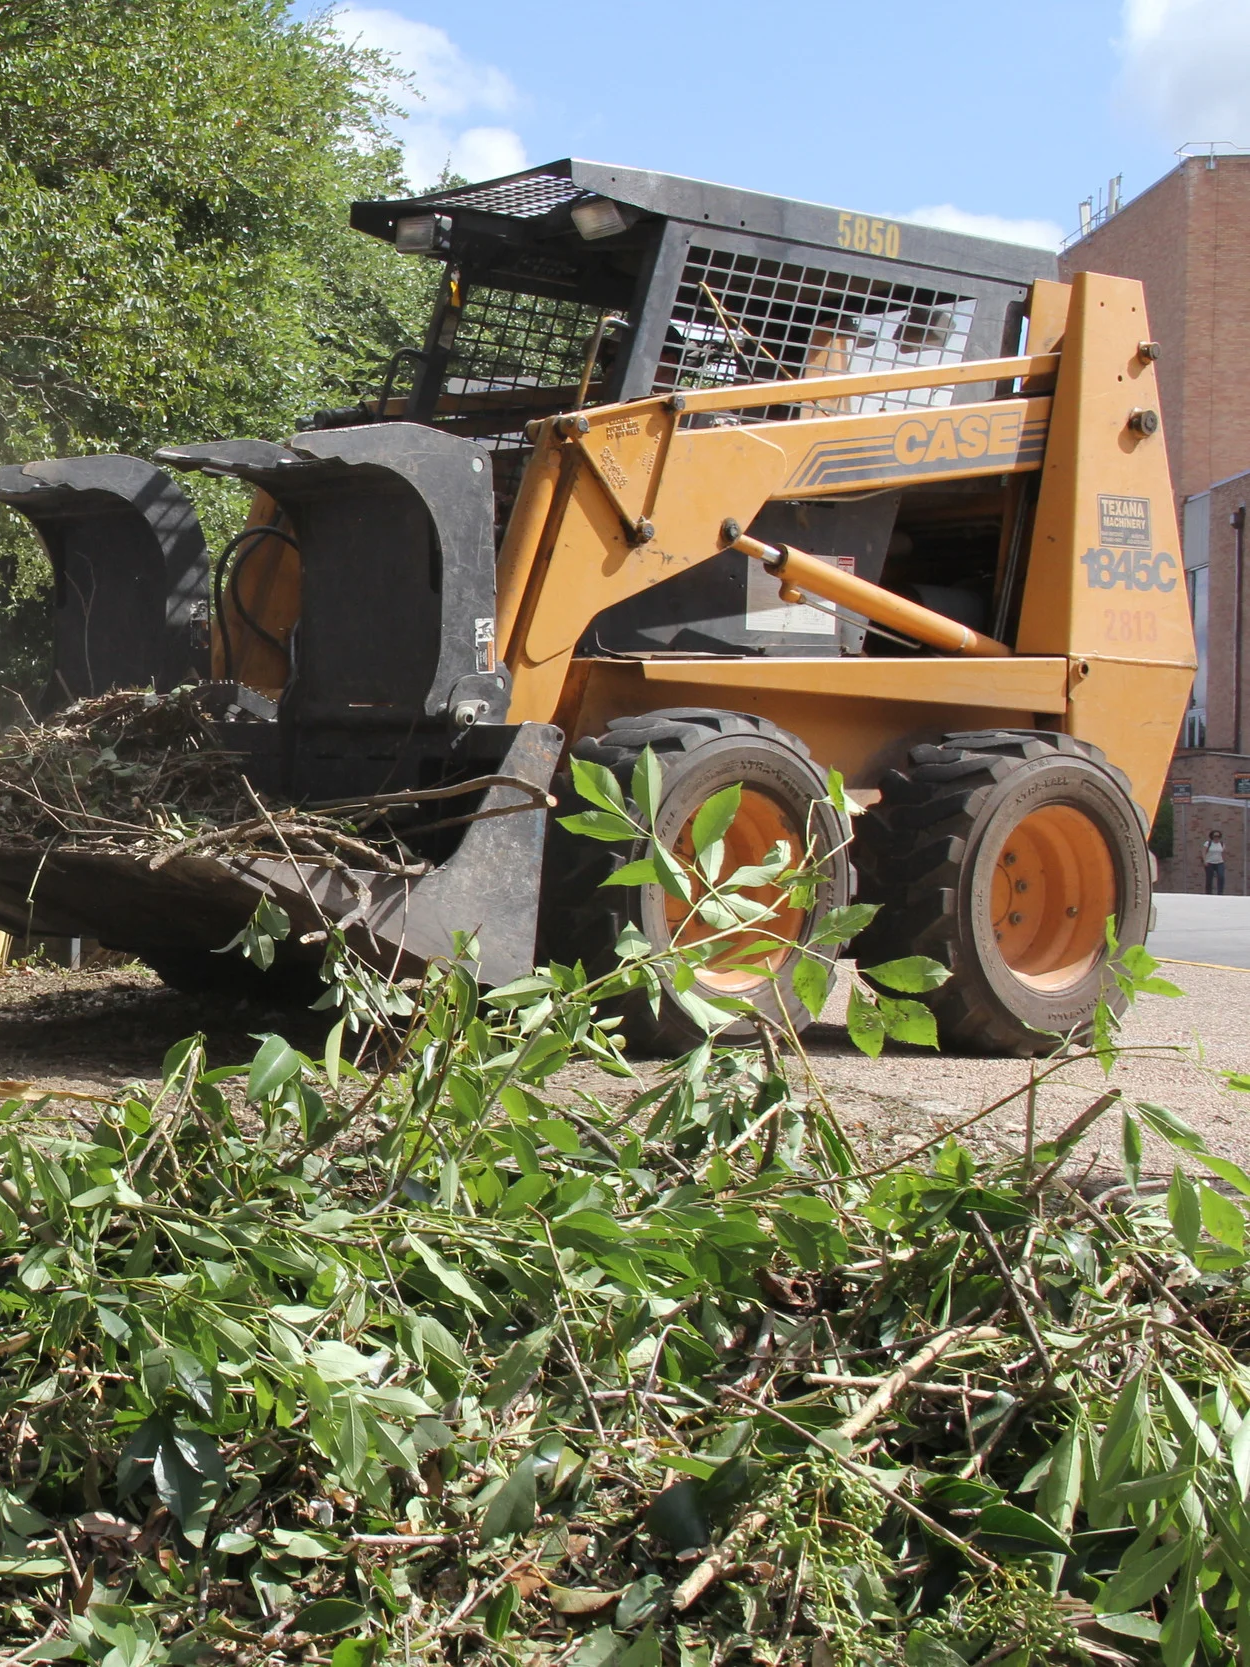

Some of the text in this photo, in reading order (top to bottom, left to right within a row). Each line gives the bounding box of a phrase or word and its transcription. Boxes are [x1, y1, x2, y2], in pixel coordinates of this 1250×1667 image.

[837, 211, 900, 259] 5850
[892, 411, 1023, 465] CASE
[1101, 499, 1145, 518] TEXANA
[1103, 516, 1146, 530] MACHINERY
[1081, 547, 1177, 593] 1845C
[1103, 610, 1157, 641] 2813
